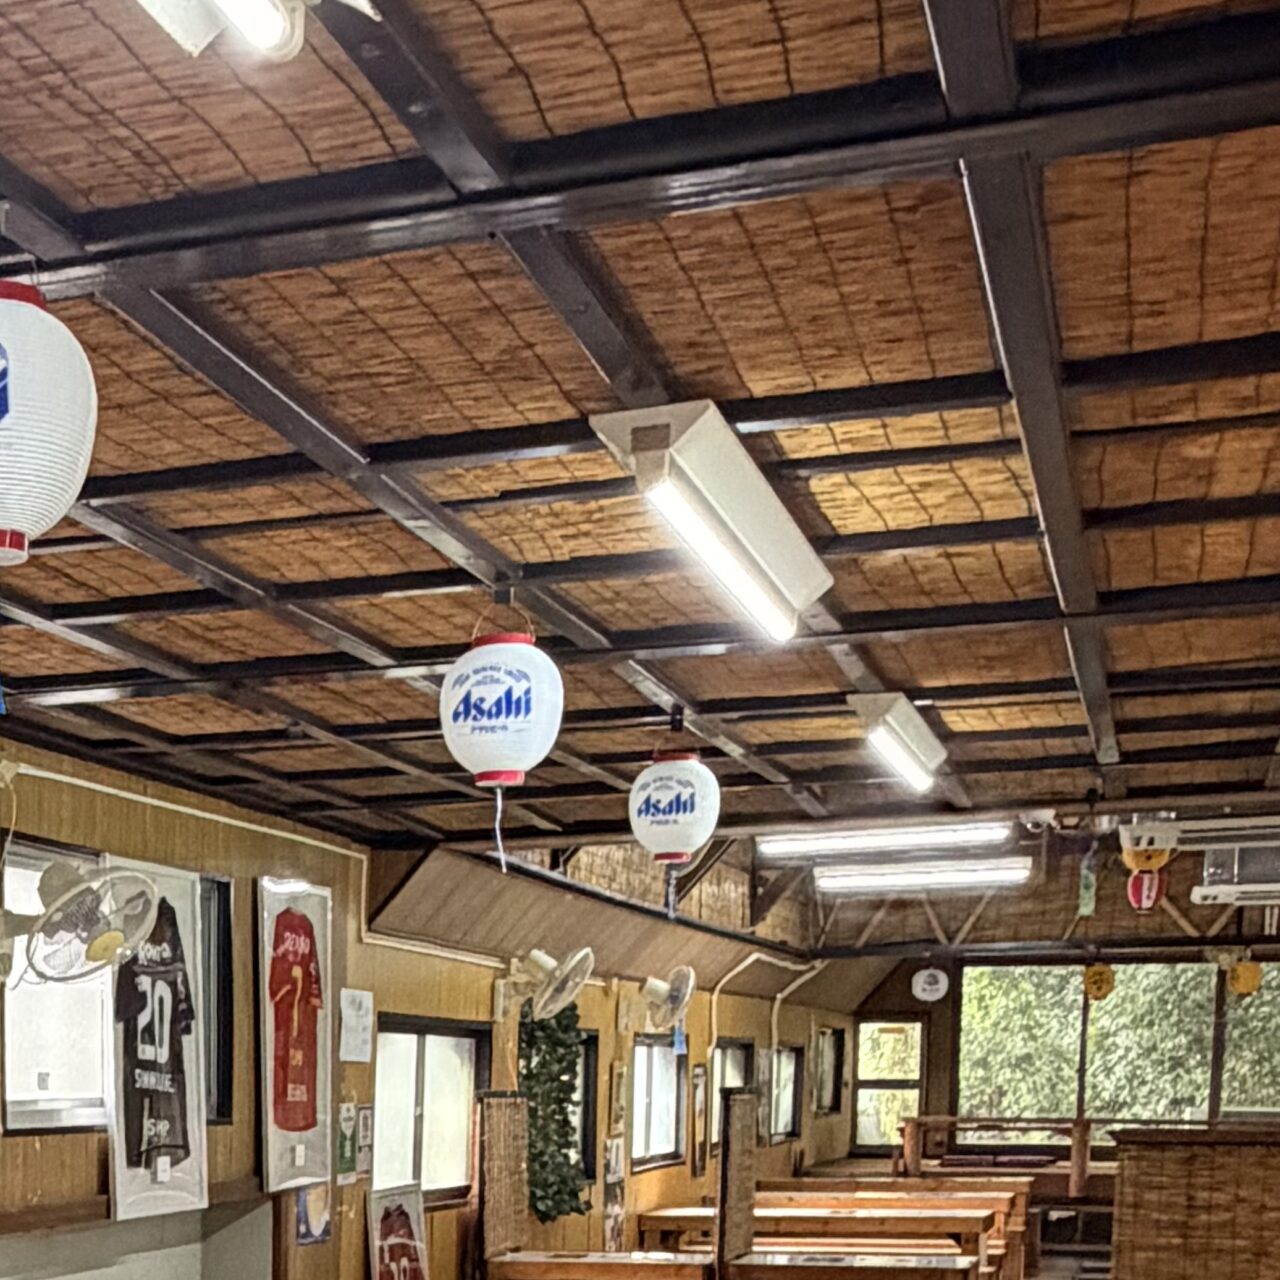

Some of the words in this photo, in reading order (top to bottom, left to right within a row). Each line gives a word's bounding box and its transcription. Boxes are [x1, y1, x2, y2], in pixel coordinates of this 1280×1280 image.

[452, 685, 532, 724] Asahi
[637, 791, 696, 818] Asahi
[134, 974, 173, 1063] 20
